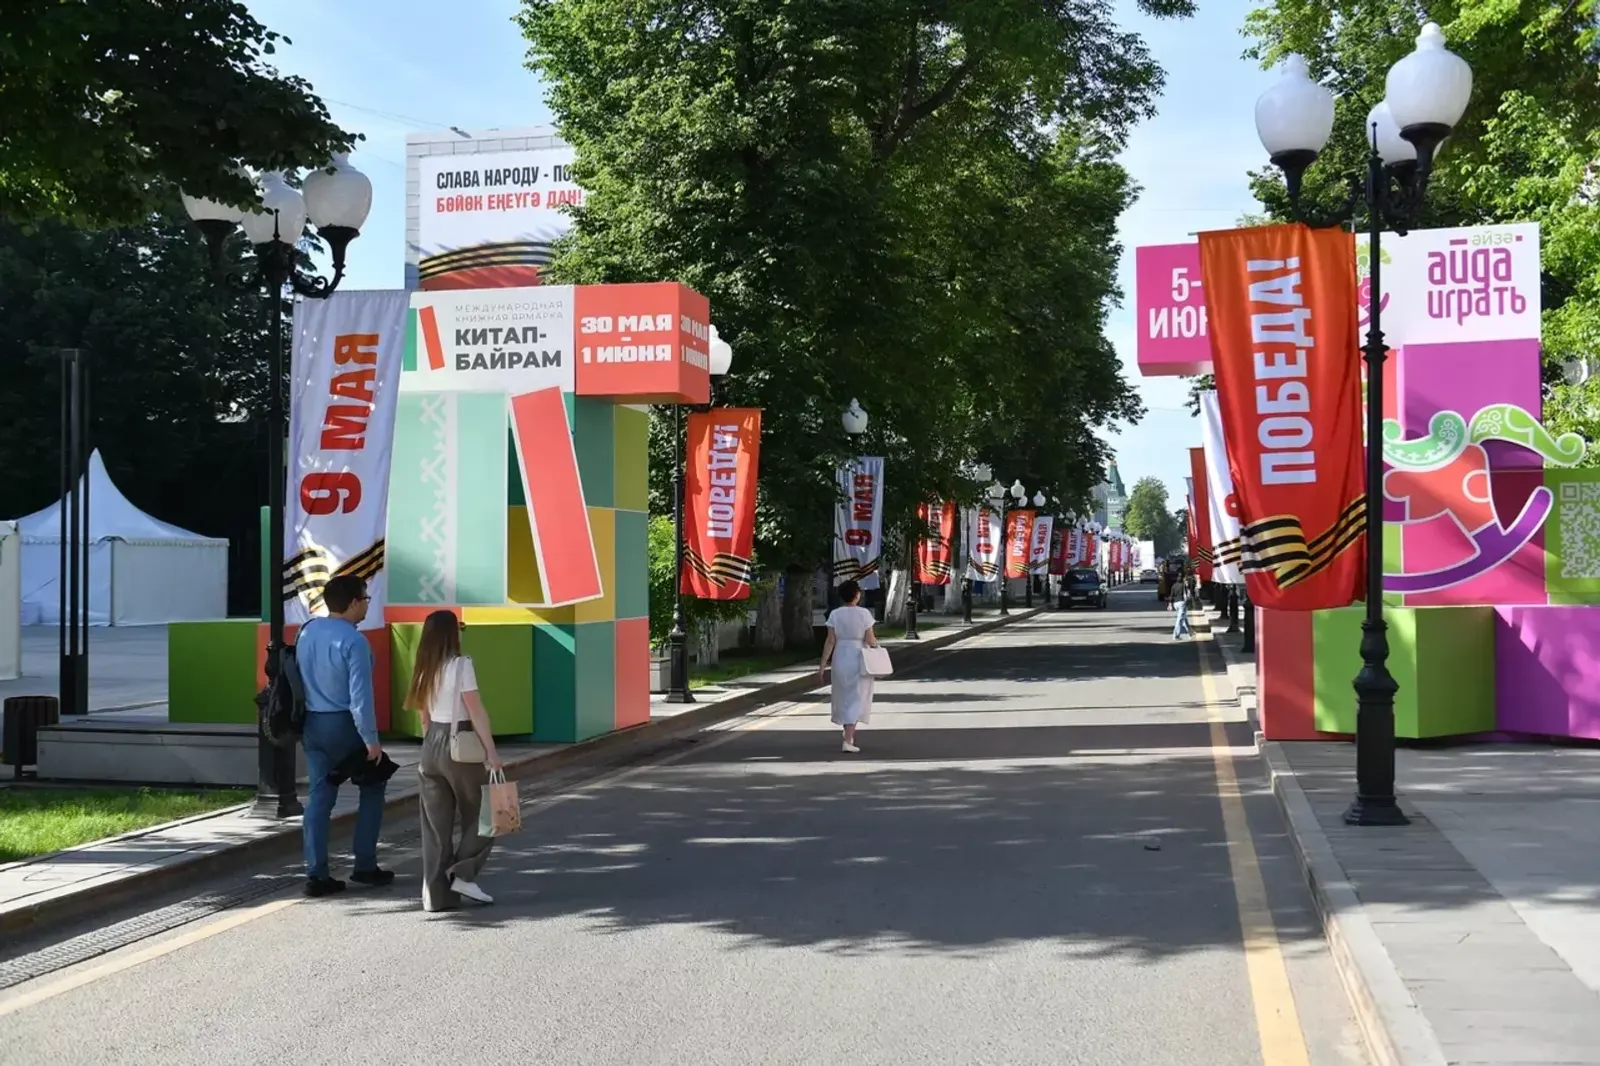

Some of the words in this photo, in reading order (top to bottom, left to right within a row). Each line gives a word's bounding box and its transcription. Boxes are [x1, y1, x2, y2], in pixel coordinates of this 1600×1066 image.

[436, 170, 480, 189] СЛАВА
[484, 166, 540, 187] НАРОДУ
[546, 189, 582, 209] ДАН!
[1171, 267, 1202, 302] 5-
[455, 301, 563, 313] МЕЖДУНАРОДНАЯ
[455, 314, 508, 323] КНИЖНАЯ
[512, 312, 563, 321] ЯРМАРКА
[1427, 286, 1526, 326] играть
[580, 316, 613, 334] 30
[618, 313, 672, 333] МАЯ
[455, 326, 547, 346] КИТАП-
[455, 347, 562, 371] БАЙРАМ
[581, 346, 591, 364] 1
[597, 344, 672, 364] ИЮНЯ
[1246, 256, 1317, 486] ПОБЕДА!
[319, 333, 380, 451] МАЯ
[300, 471, 362, 516] 9
[854, 474, 874, 522] МАЯ
[844, 528, 872, 546] 9
